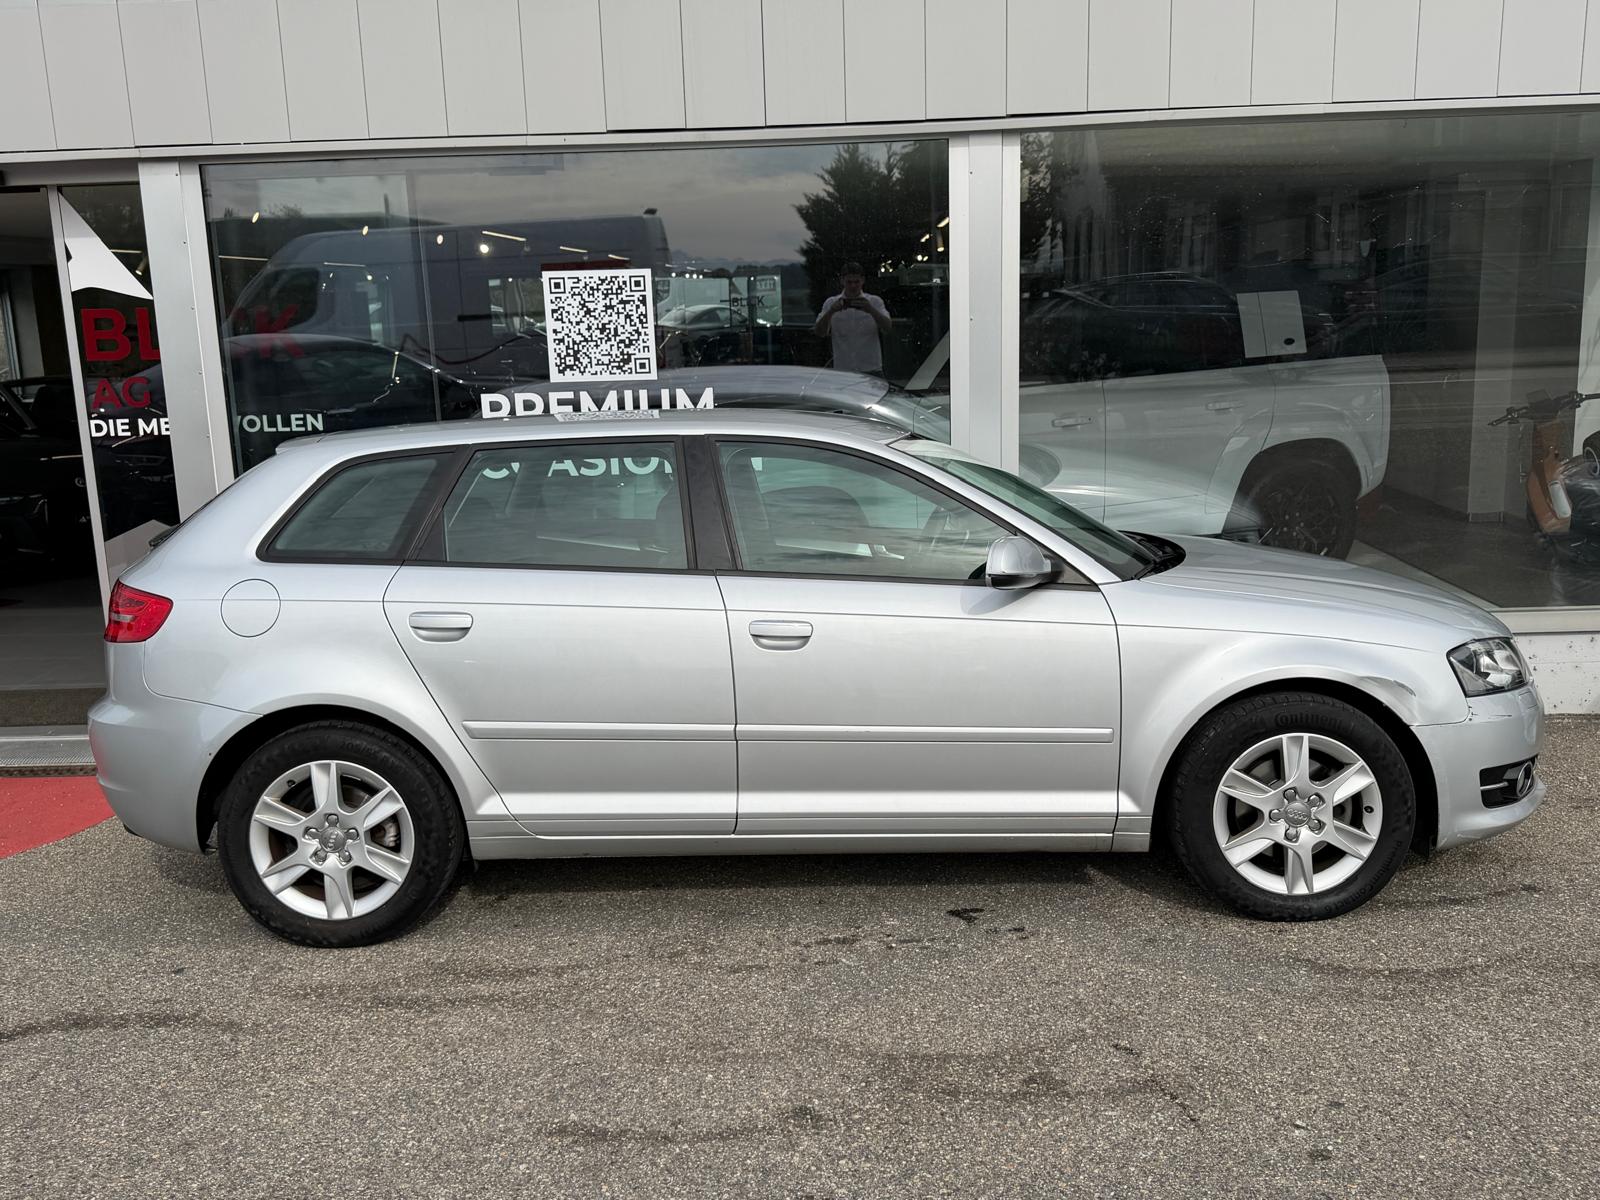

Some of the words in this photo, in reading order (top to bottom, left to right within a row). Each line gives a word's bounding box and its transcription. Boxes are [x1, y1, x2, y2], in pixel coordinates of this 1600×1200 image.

[92, 376, 152, 409] AG
[90, 418, 132, 437] DIE
[138, 417, 172, 436] ME
[238, 414, 324, 432] OLLEN
